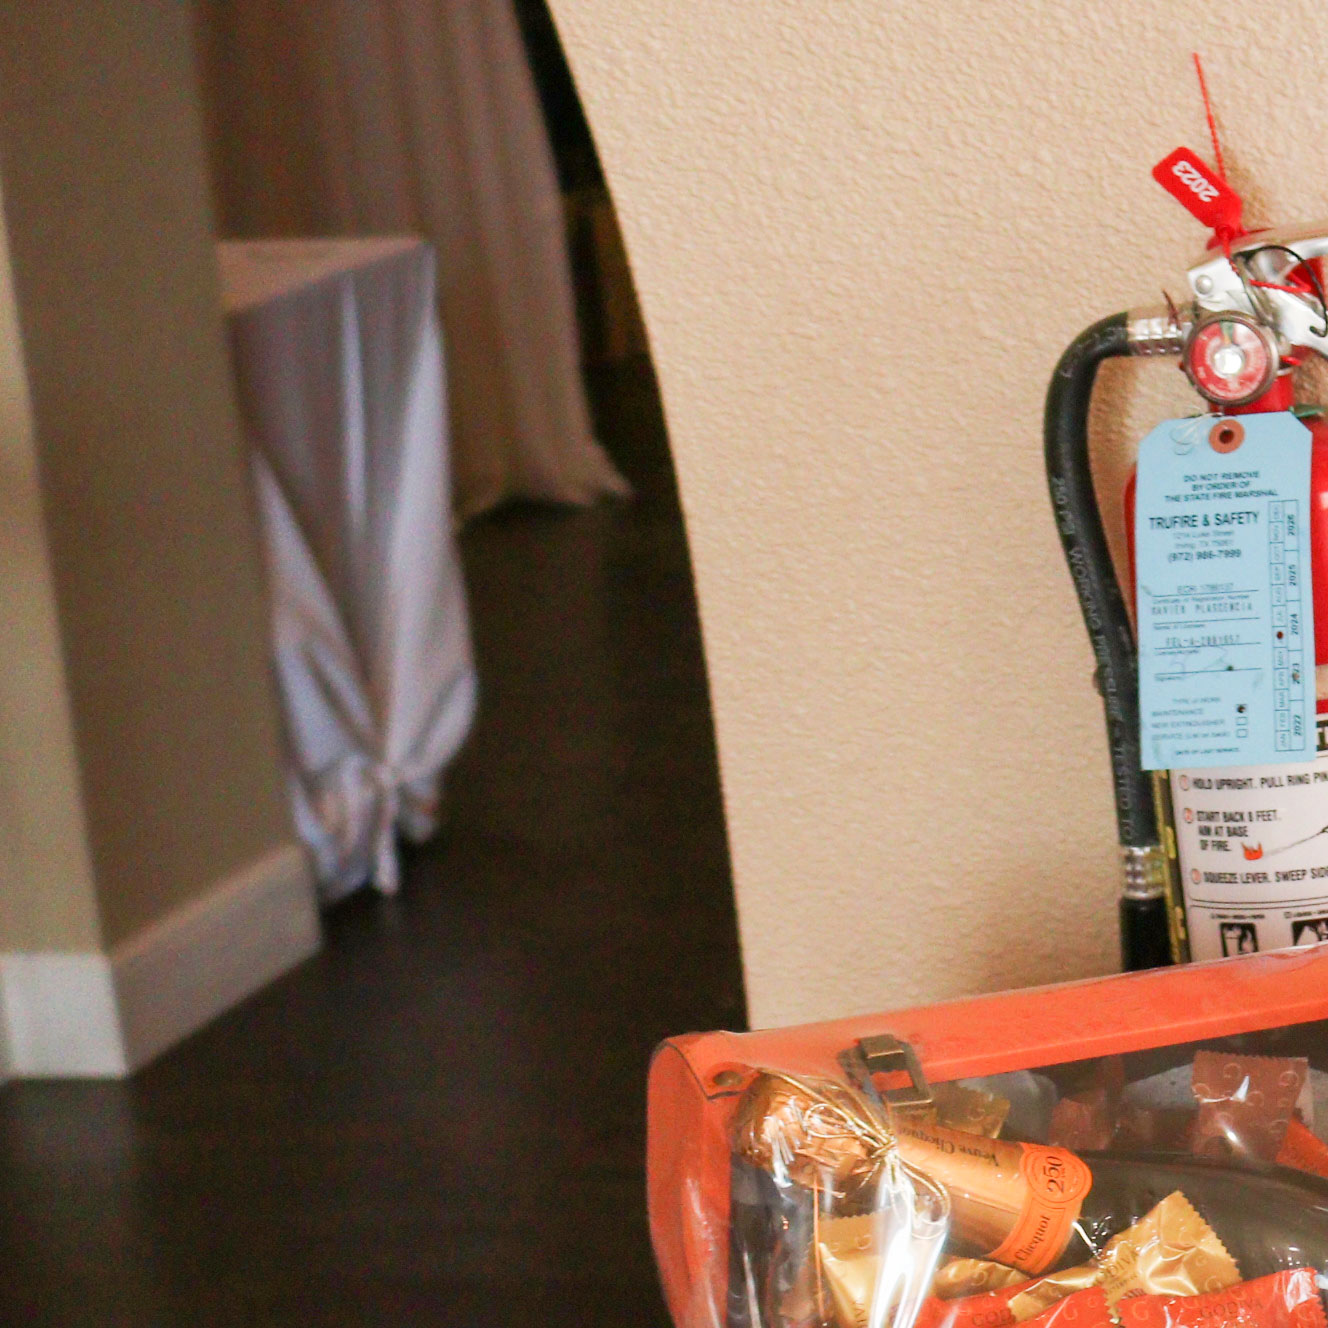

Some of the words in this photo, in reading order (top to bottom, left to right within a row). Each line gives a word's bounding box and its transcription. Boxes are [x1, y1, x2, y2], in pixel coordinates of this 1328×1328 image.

[1172, 160, 1219, 203] 2023
[1200, 473, 1218, 481] NOT
[1222, 471, 1259, 480] REMOVE
[1149, 516, 1198, 529] TRUFIRE
[1203, 514, 1210, 526] &
[1215, 511, 1259, 525] SAFETY
[1288, 564, 1296, 586] 2025
[1261, 775, 1284, 788] PULL
[1287, 773, 1309, 785] RING
[1275, 868, 1307, 882] SWEEP
[1312, 865, 1328, 879] SIDE
[1043, 1156, 1065, 1193] 250
[1015, 1215, 1050, 1261] Clicquot
